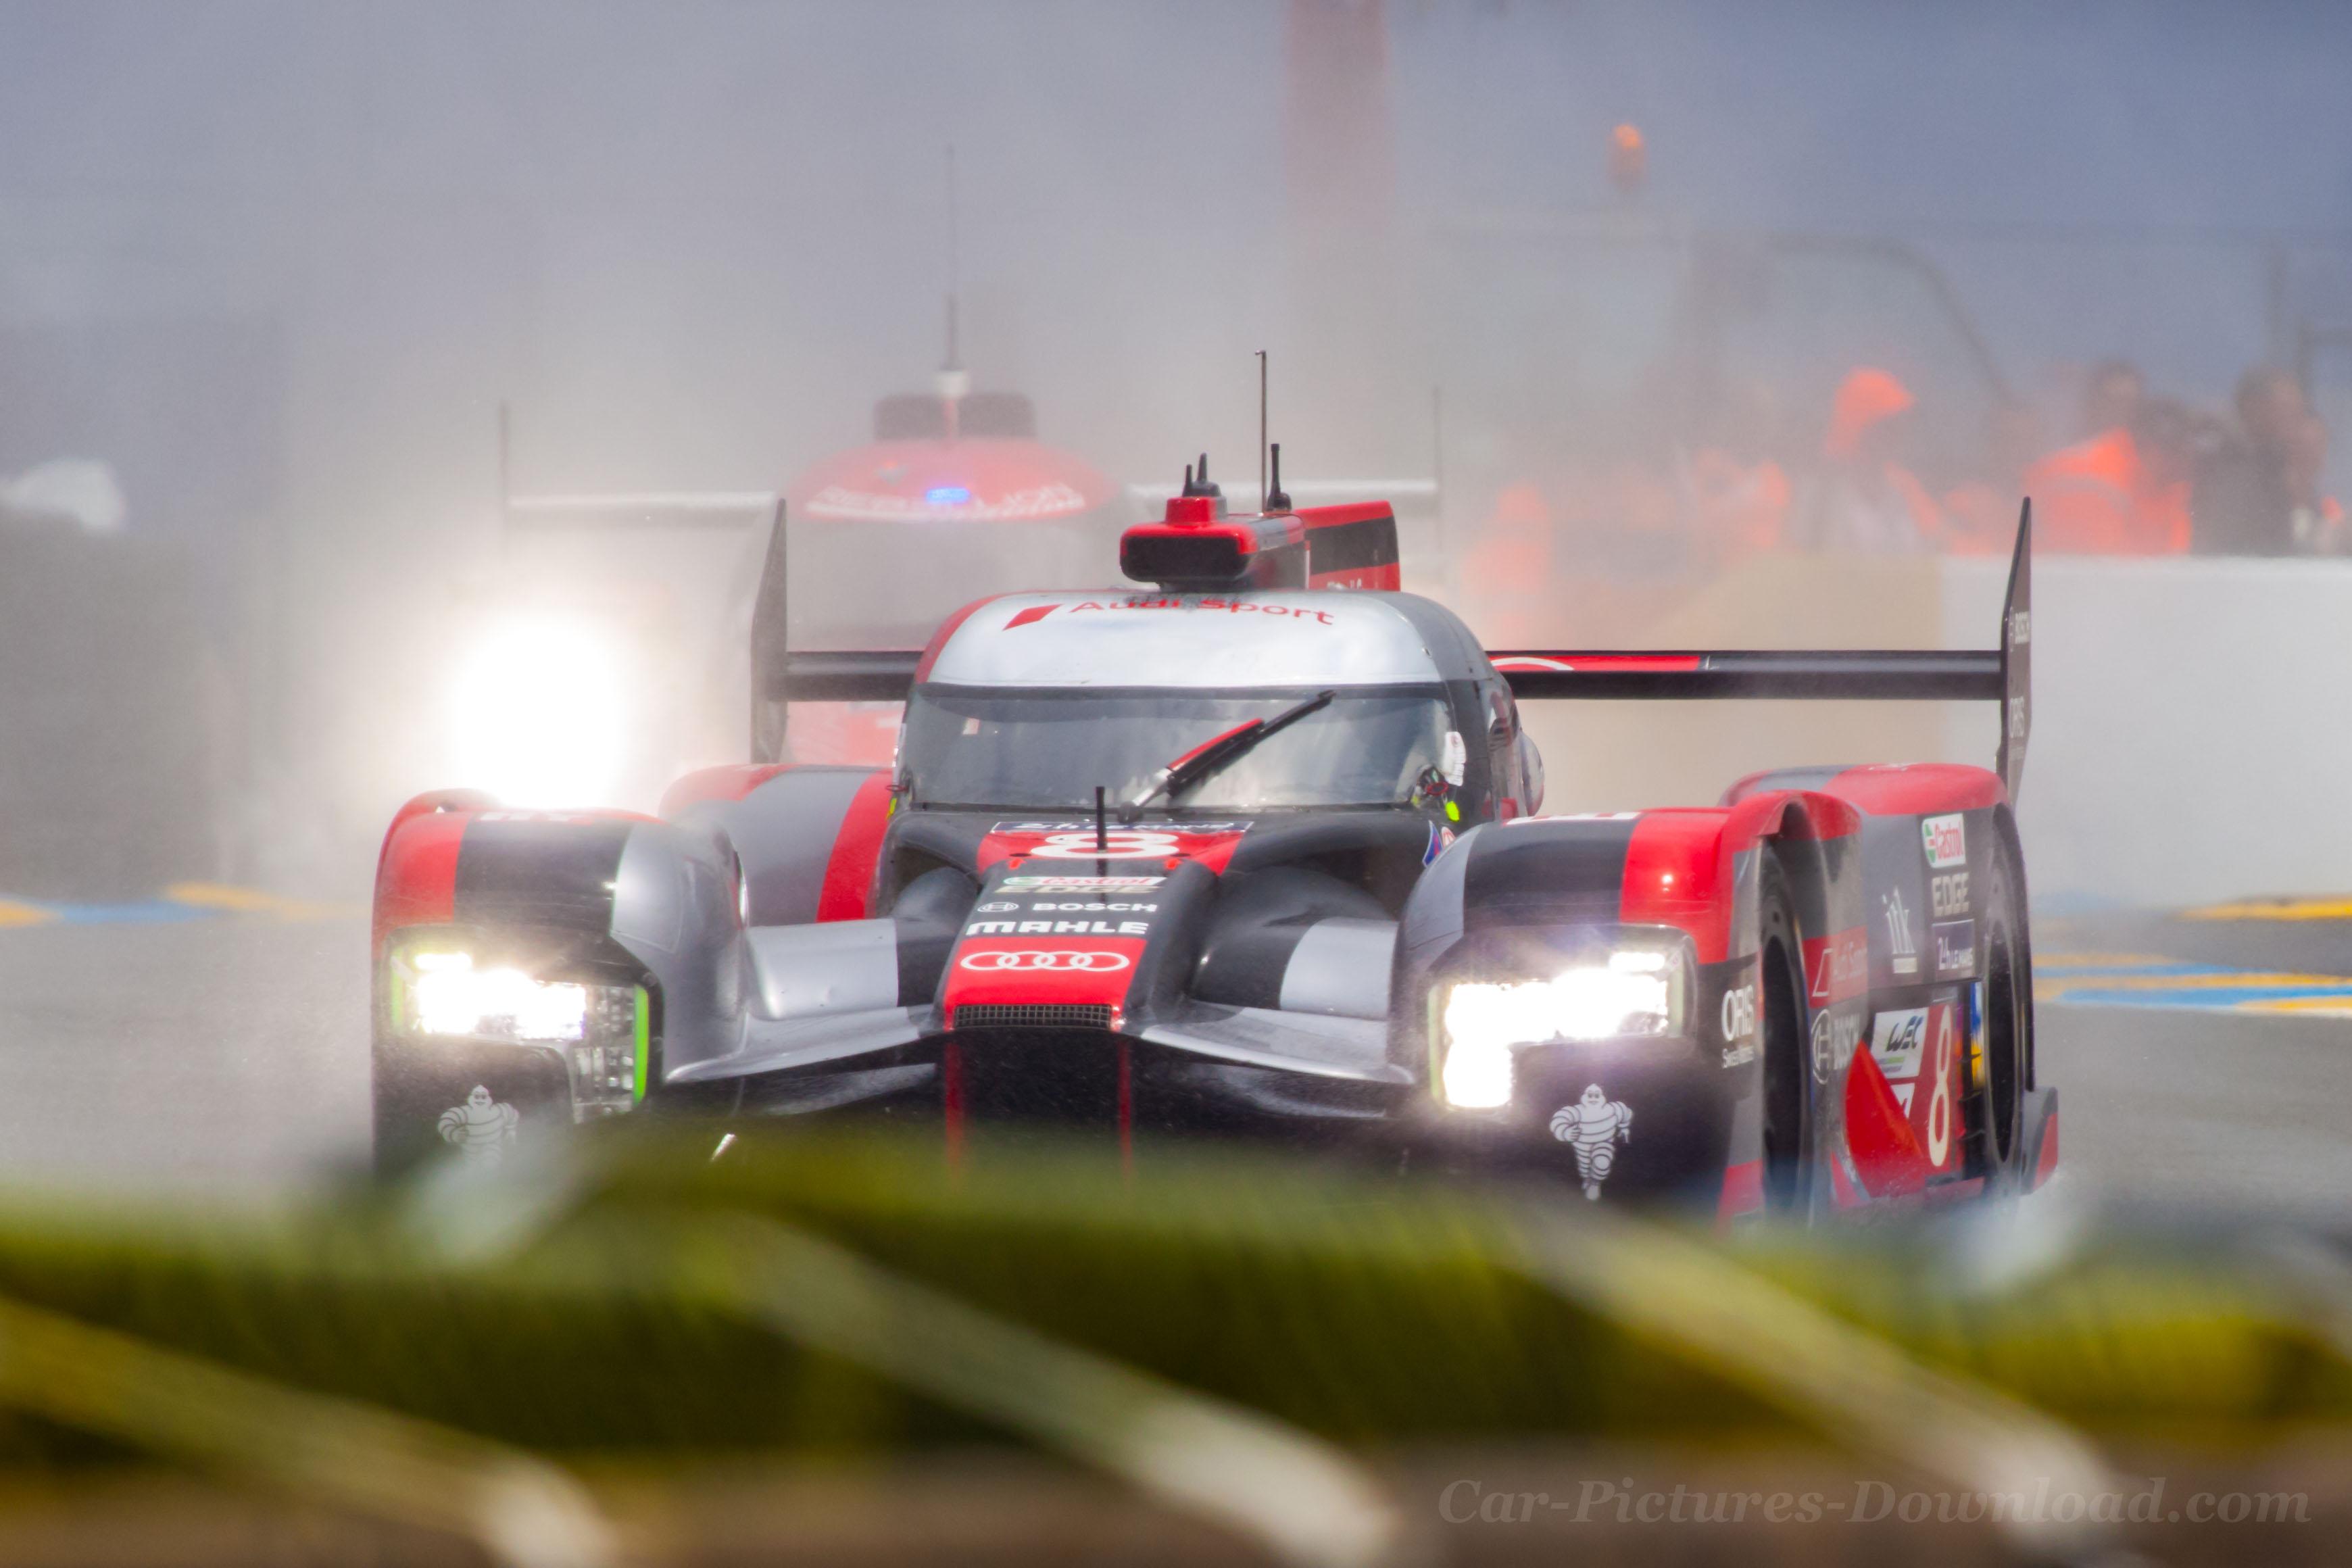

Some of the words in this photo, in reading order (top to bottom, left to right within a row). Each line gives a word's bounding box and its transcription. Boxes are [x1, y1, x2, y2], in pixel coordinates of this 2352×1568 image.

[1069, 597, 1180, 613] Audi
[1198, 597, 1334, 625] Sport
[1030, 832, 1179, 858] 8
[994, 885, 1165, 893] EDGE
[1041, 876, 1153, 885] Castrol
[1031, 902, 1158, 912] BOSCH
[1931, 872, 1969, 917] EDGE
[965, 921, 1149, 936] MAHLE
[1721, 984, 1754, 1042] ORIS
[1884, 1015, 1924, 1052] WEC
[1928, 1004, 1952, 1167] 8
